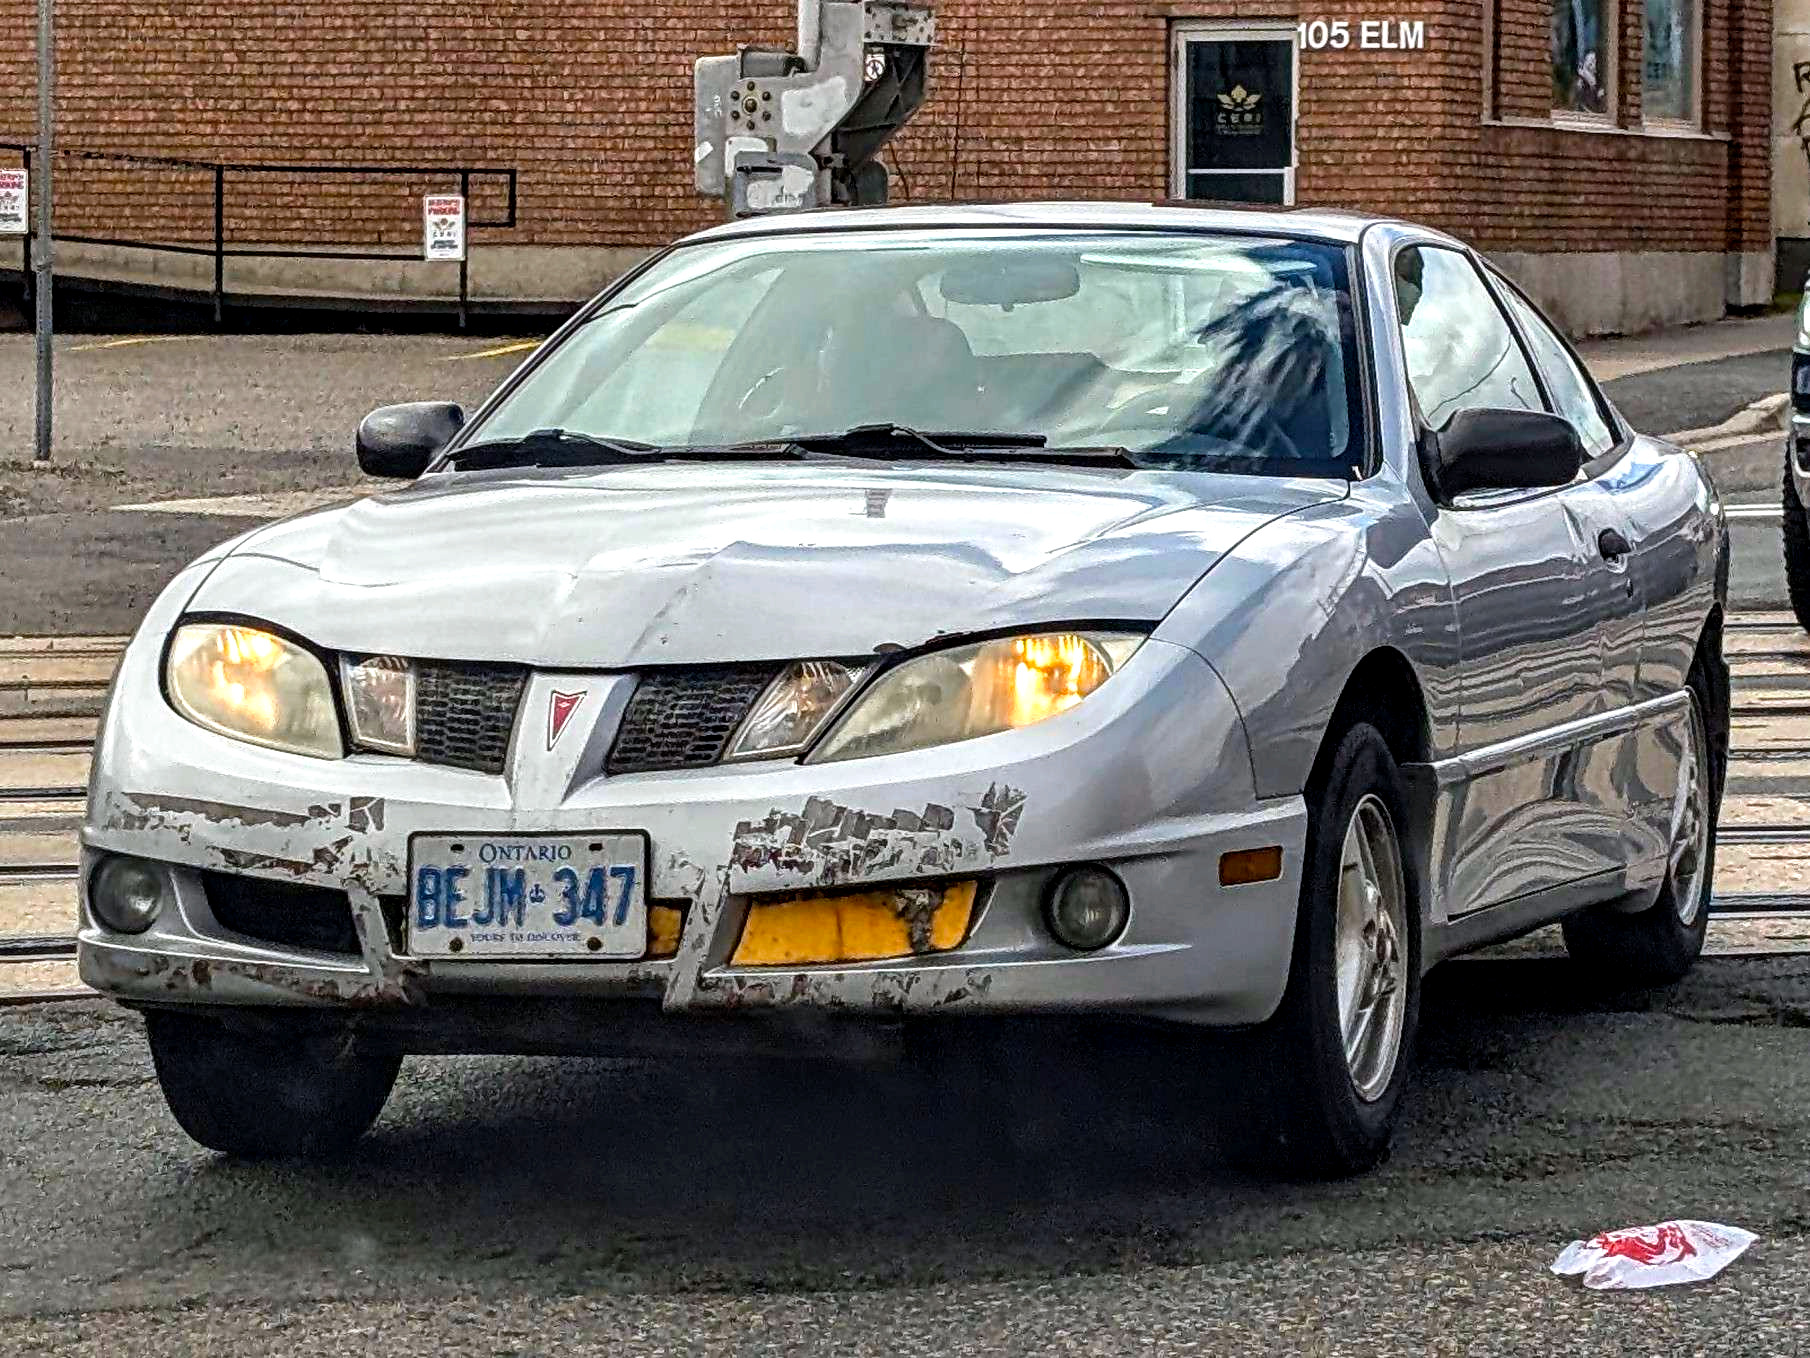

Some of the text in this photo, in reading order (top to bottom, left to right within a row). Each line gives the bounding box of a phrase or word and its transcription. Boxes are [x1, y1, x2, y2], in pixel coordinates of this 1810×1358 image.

[1297, 20, 1425, 50] 105 ELM
[479, 843, 572, 862] ONTARIO
[417, 865, 636, 928] BEJM 347
